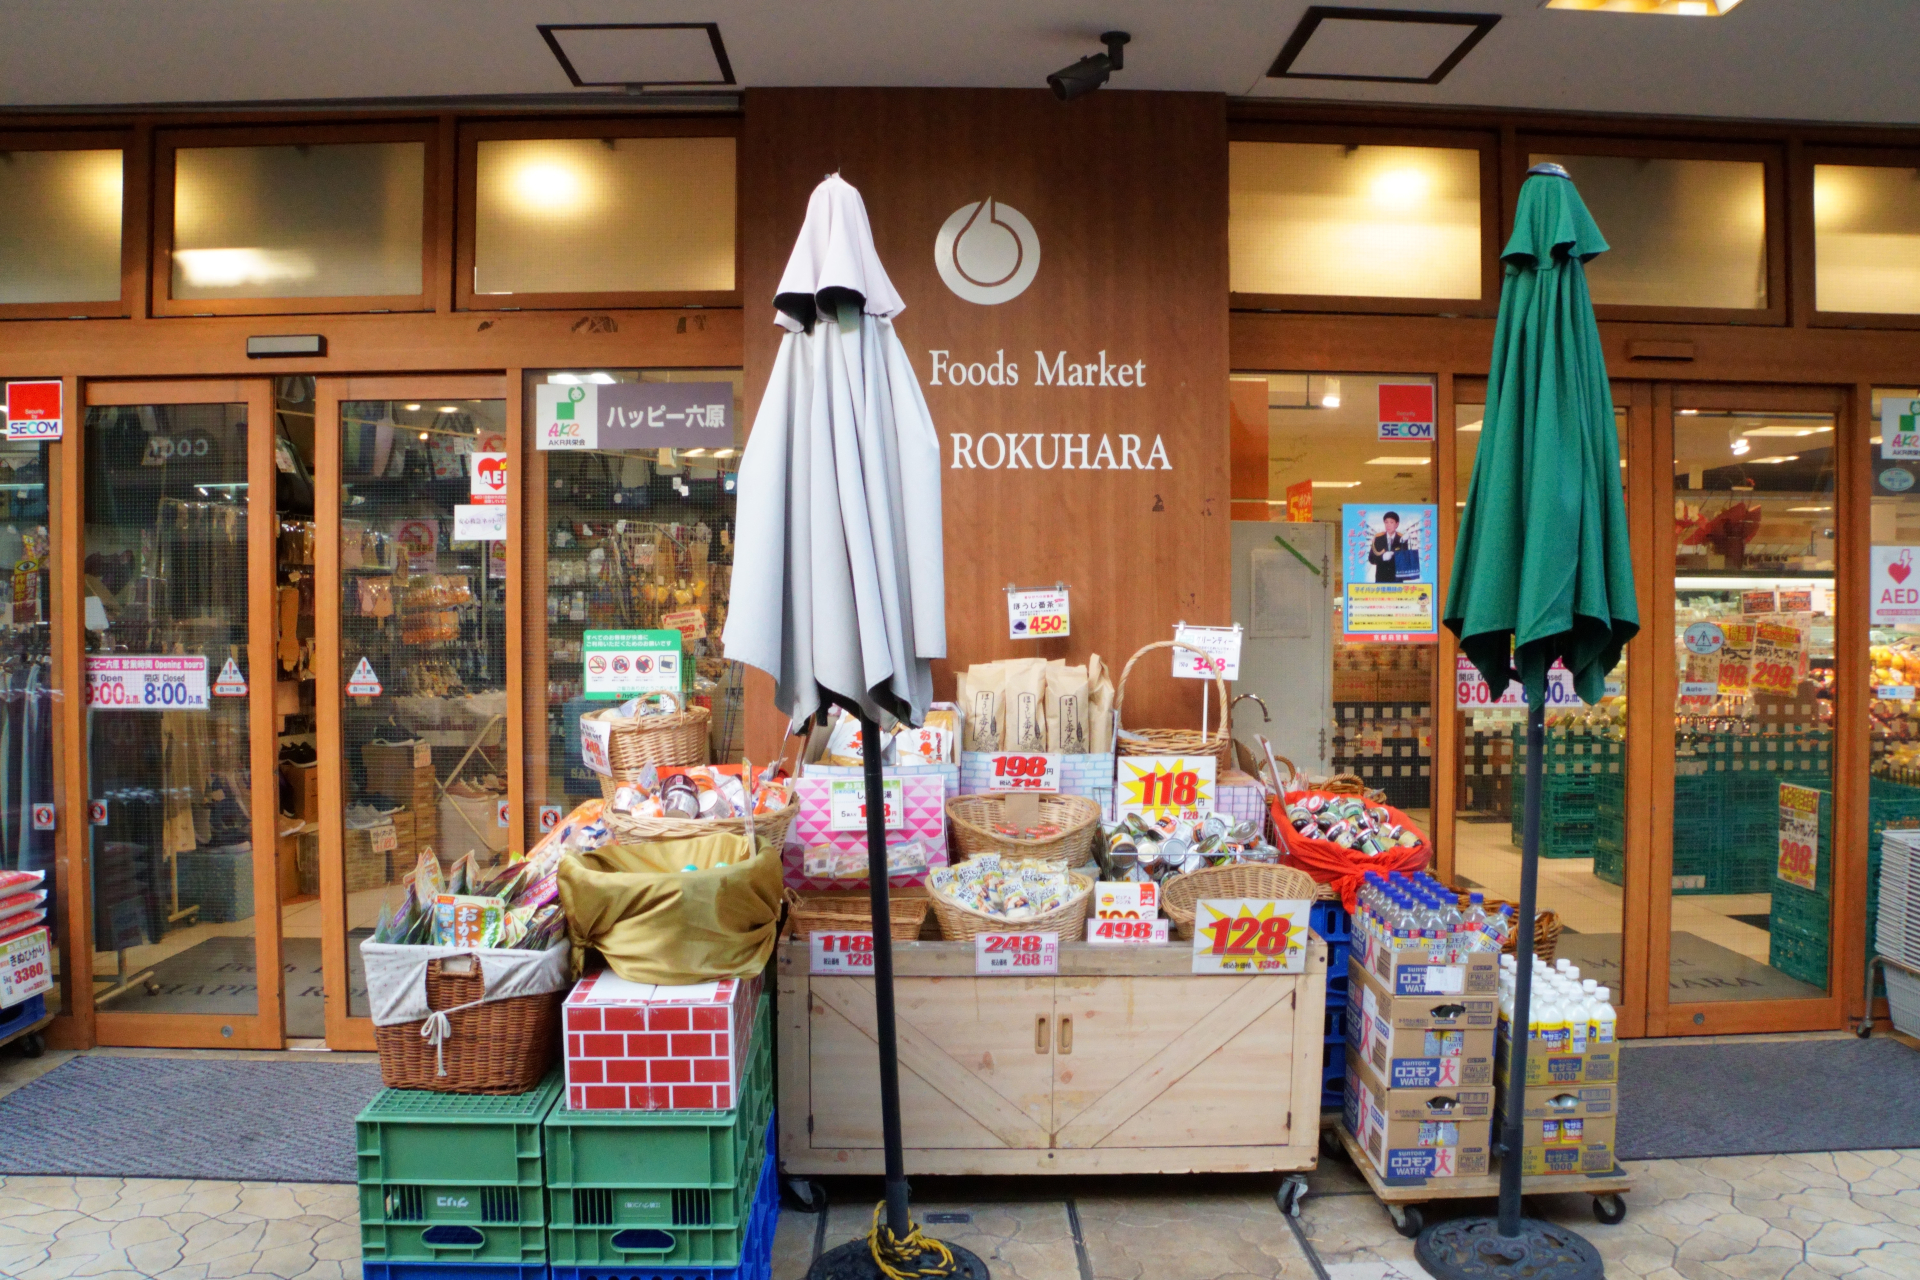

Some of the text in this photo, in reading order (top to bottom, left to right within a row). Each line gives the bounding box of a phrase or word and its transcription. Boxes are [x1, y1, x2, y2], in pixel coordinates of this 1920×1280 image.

[929, 349, 1146, 387] Foods Market
[607, 405, 725, 428] ハッピー六原
[11, 421, 58, 434] SECOM
[1382, 423, 1431, 437] SECOM
[951, 433, 1172, 470] ROKUHARA
[1880, 588, 1919, 604] AED
[1030, 615, 1061, 632] 450
[155, 659, 181, 670] Opening
[184, 660, 203, 669] hours
[1193, 657, 1226, 671] 348
[100, 674, 123, 683] Open
[163, 674, 185, 682] Closed
[1751, 662, 1794, 688] 298
[144, 682, 187, 704] 8:00
[188, 694, 203, 705] p.m.
[1458, 682, 1502, 703] 9:0
[992, 756, 1048, 777] 198
[1139, 772, 1205, 806] 118 円
[1183, 811, 1199, 820] 128
[1779, 838, 1812, 876] 298
[458, 907, 478, 947] おかか
[1096, 922, 1165, 939] 498 円
[818, 935, 873, 952] 118
[984, 936, 1054, 953] 248 円
[1209, 917, 1291, 956] 128
[10, 943, 45, 967] きぬひかり
[846, 953, 873, 967] 128
[1013, 954, 1040, 966] 268
[1044, 956, 1053, 965] 円
[14, 962, 43, 984] 3380
[1258, 960, 1280, 969] 139
[1395, 1067, 1437, 1077] ロコモア
[1550, 1062, 1580, 1071] セサミン
[1553, 1073, 1576, 1081] 1000
[1391, 1157, 1433, 1167] ロコモア
[1547, 1154, 1576, 1162] セサミン
